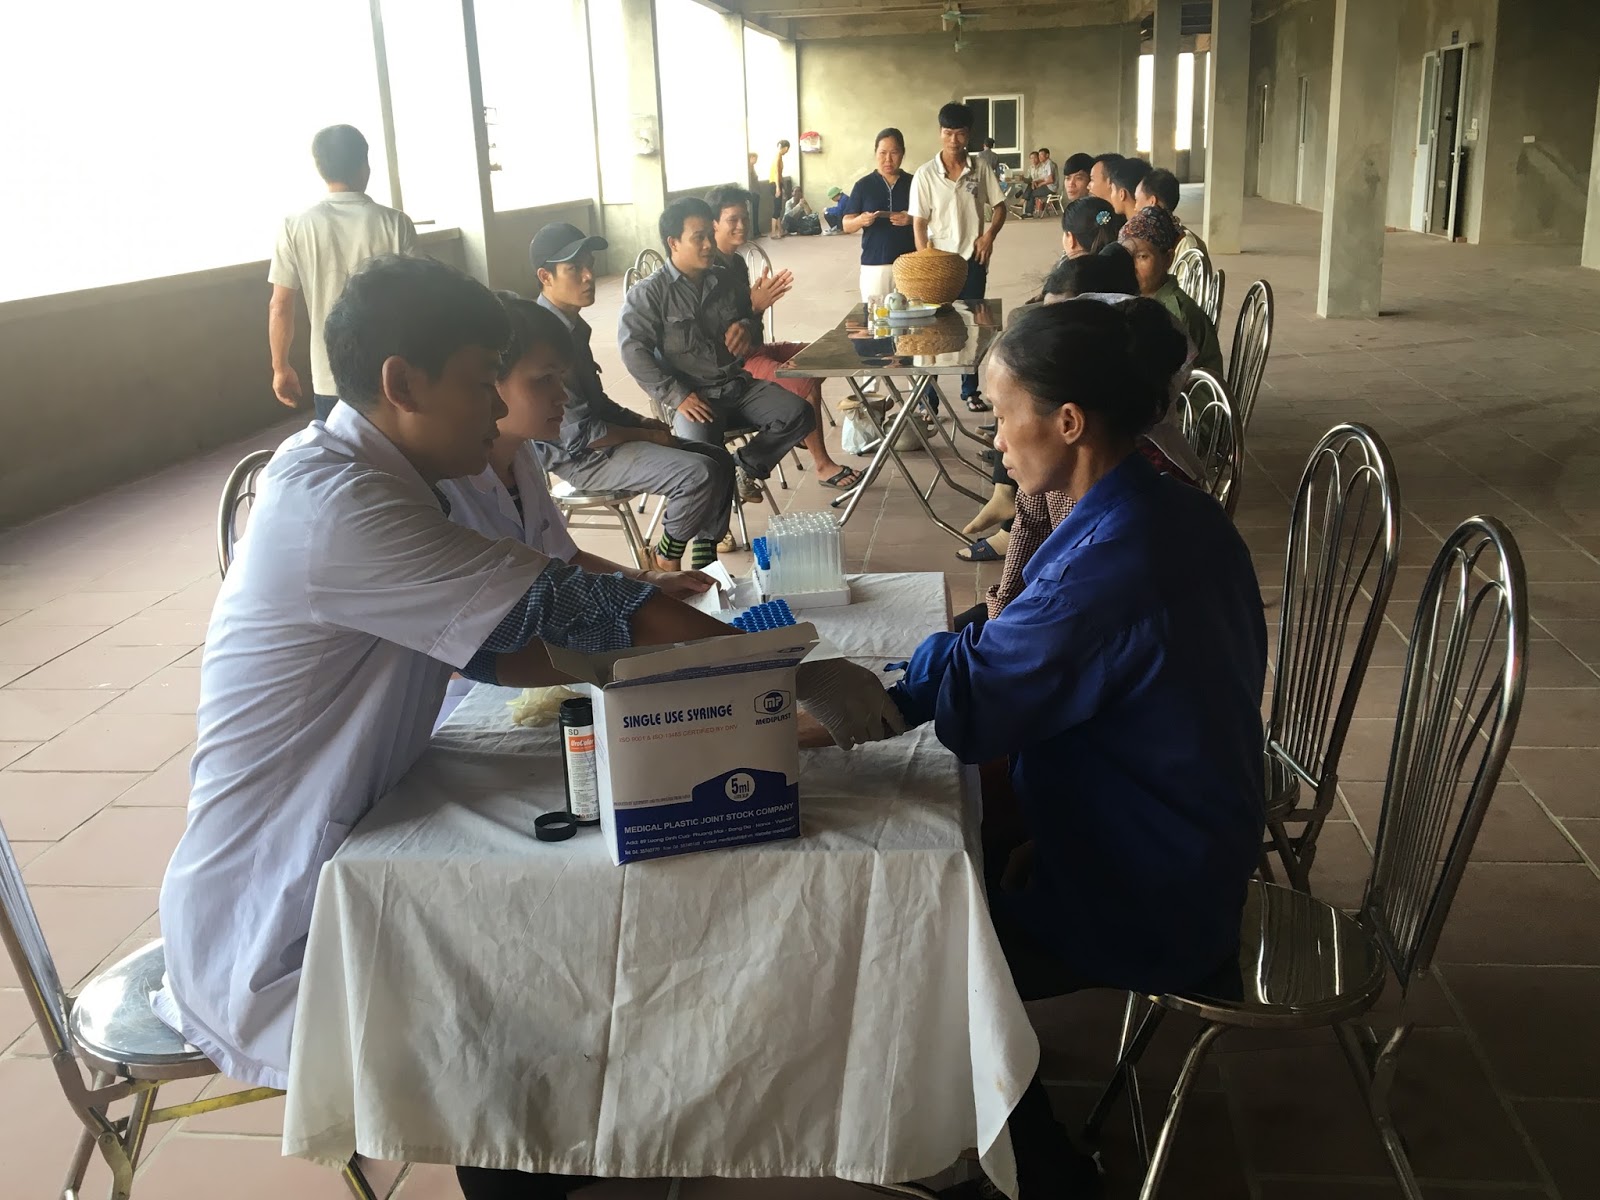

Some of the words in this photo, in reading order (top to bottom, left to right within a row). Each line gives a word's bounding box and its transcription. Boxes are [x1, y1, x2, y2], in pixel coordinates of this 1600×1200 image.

[623, 713, 661, 729] SINGLE
[664, 710, 684, 725] USE
[687, 704, 733, 721] SYRINGE
[755, 712, 792, 726] MEDIPLAST
[568, 728, 579, 736] SD
[682, 727, 715, 737] CERTIFIED
[731, 777, 750, 795] 5ml
[624, 822, 662, 834] MEDICAL
[664, 818, 699, 830] PLASTIC
[700, 814, 725, 825] JOINT
[726, 810, 755, 821] STOCK
[755, 802, 794, 817] COMPANY
